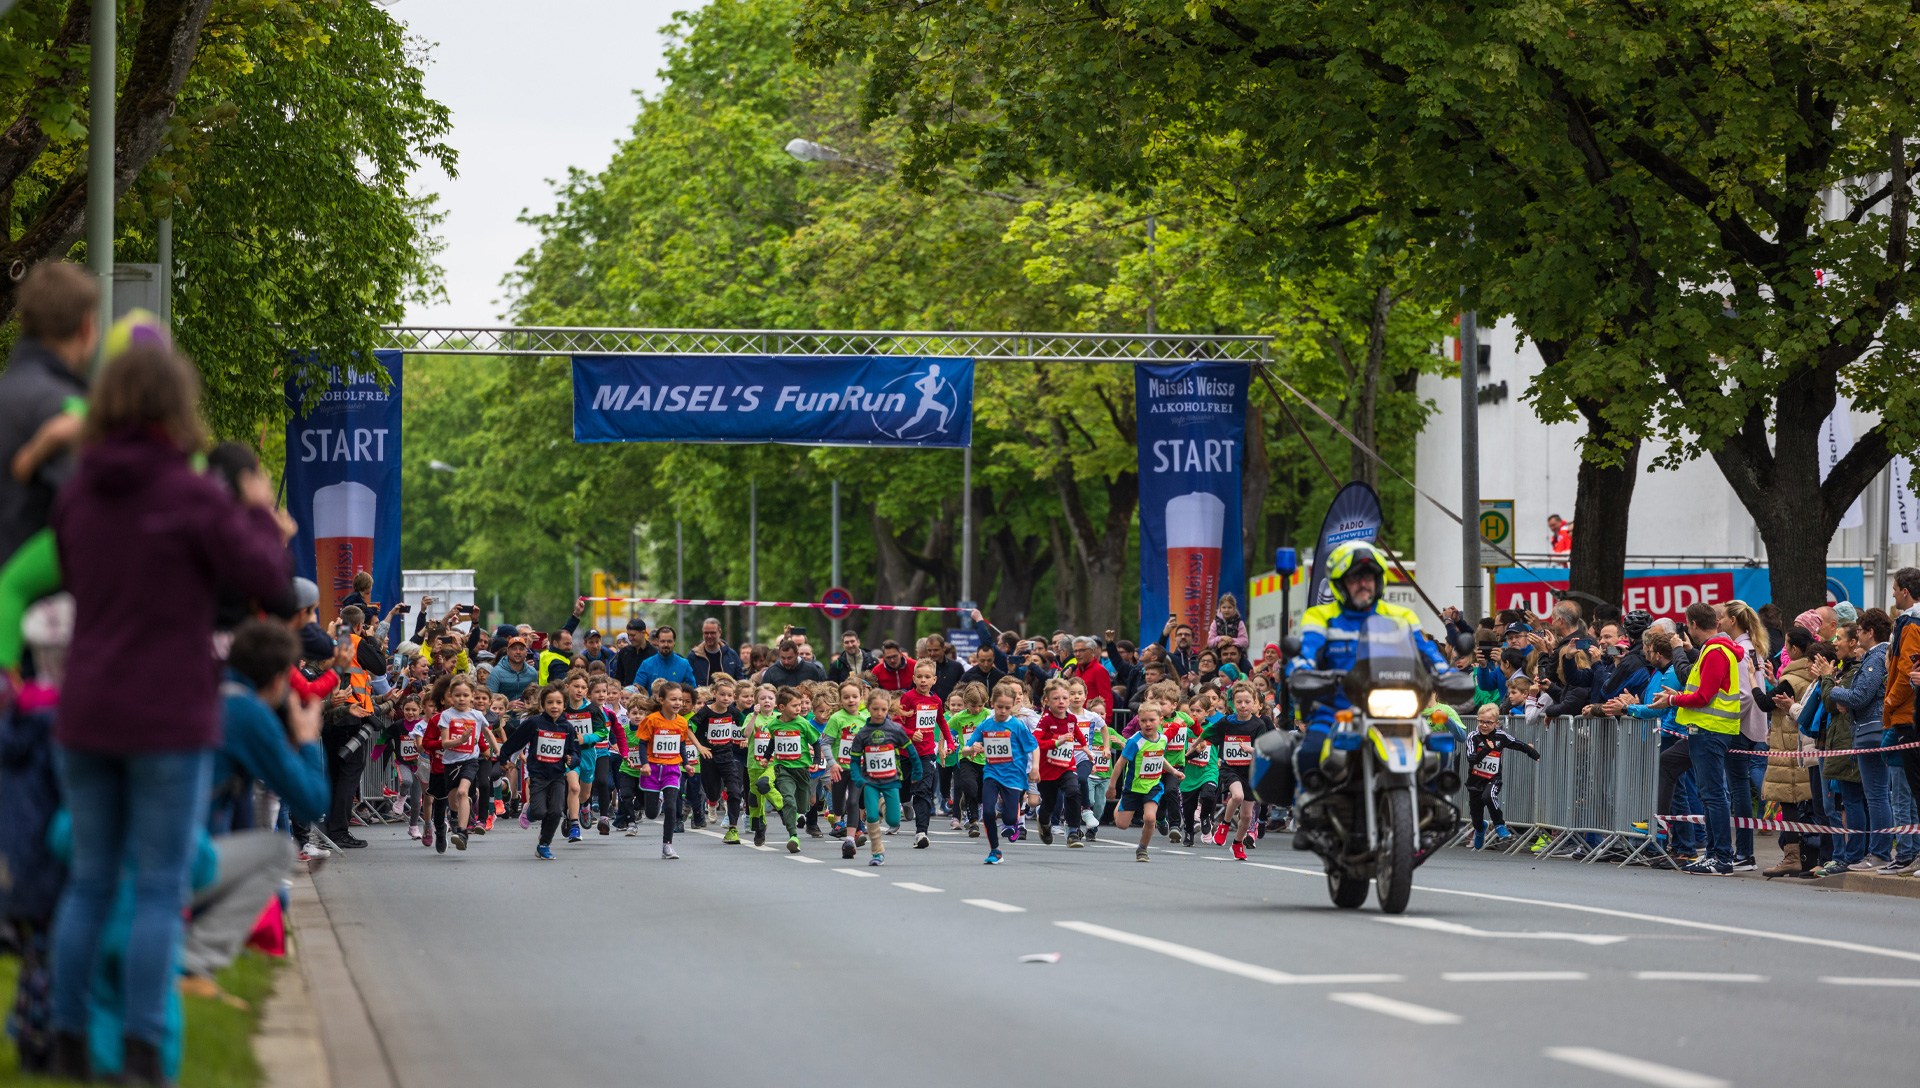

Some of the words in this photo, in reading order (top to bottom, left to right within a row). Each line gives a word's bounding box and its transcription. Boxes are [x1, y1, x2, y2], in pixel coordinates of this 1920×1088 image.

[1149, 377, 1194, 398] Maisel's
[1196, 376, 1235, 397] Weisse
[592, 385, 764, 412] MAISEL'S
[773, 385, 907, 413] FunRun
[1150, 402, 1233, 413] ALKOHOLFREI
[301, 428, 389, 463] START
[1153, 439, 1235, 473] START
[1340, 520, 1364, 531] RADIO
[1485, 518, 1499, 537] H
[1328, 529, 1373, 543] MAINWELLE
[334, 543, 353, 591] Weisse
[1185, 552, 1204, 600] Weisse
[1203, 575, 1214, 630] ALKOHOLFREI
[1378, 671, 1412, 680] POLIZEI
[711, 728, 730, 738] 6010
[540, 743, 562, 755] 6062
[656, 741, 677, 751] 6101
[777, 742, 799, 752] 6120
[986, 744, 1009, 755] 6139
[1051, 748, 1073, 759] 6146
[869, 757, 893, 769] 6134
[1477, 761, 1497, 772] 6145
